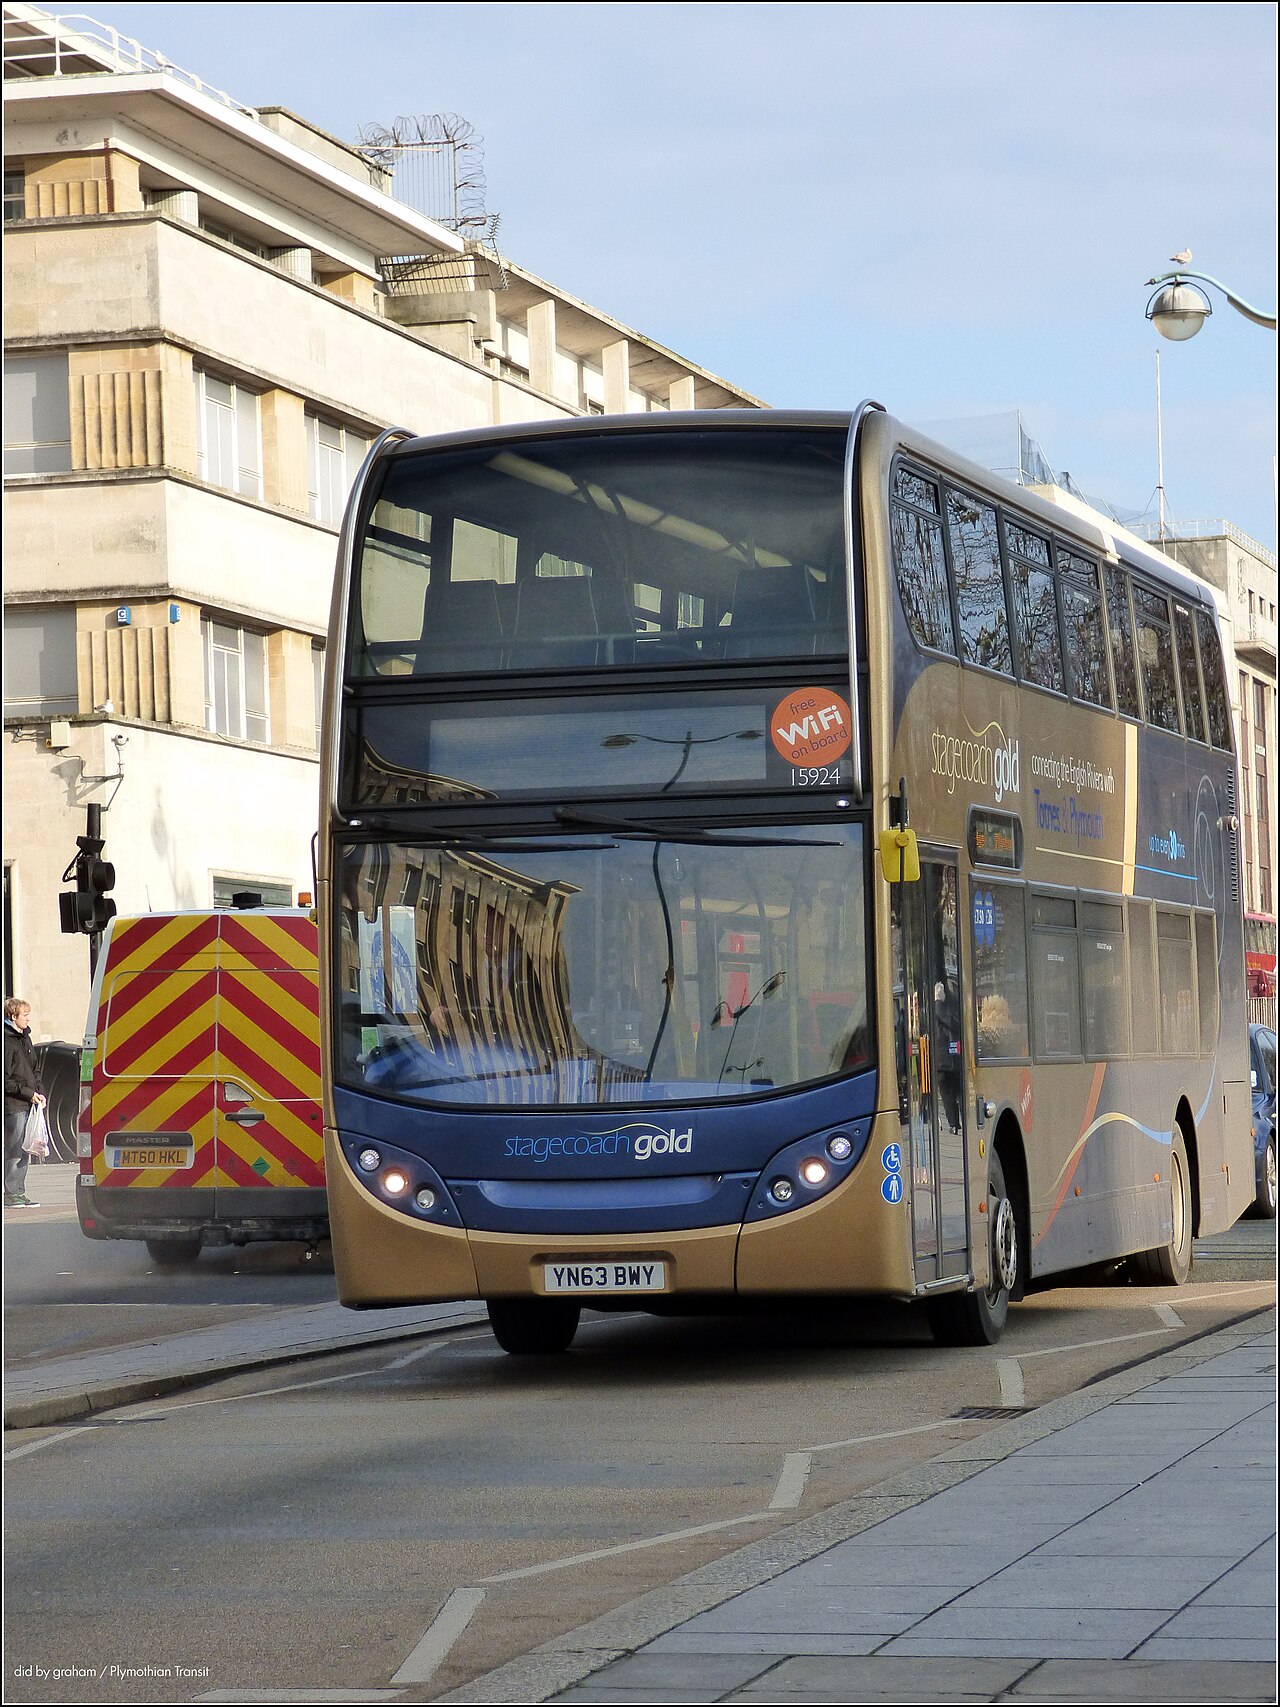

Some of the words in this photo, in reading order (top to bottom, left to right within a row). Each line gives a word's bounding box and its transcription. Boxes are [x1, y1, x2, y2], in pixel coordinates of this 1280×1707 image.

[789, 699, 816, 715] free
[777, 705, 844, 745] WiFi
[791, 747, 809, 759] on
[809, 726, 848, 751] board
[791, 768, 841, 786] 15924
[932, 727, 994, 794] stagecoach
[994, 738, 1020, 802] gold
[1031, 752, 1062, 788] connecting
[1069, 796, 1104, 846] Plymouth
[122, 1151, 156, 1164] MT60
[159, 1150, 184, 1164] HKL
[504, 1131, 631, 1162] stagecoach
[634, 1128, 693, 1160] gold
[553, 1266, 608, 1287] YN63
[614, 1265, 655, 1286] BWY
